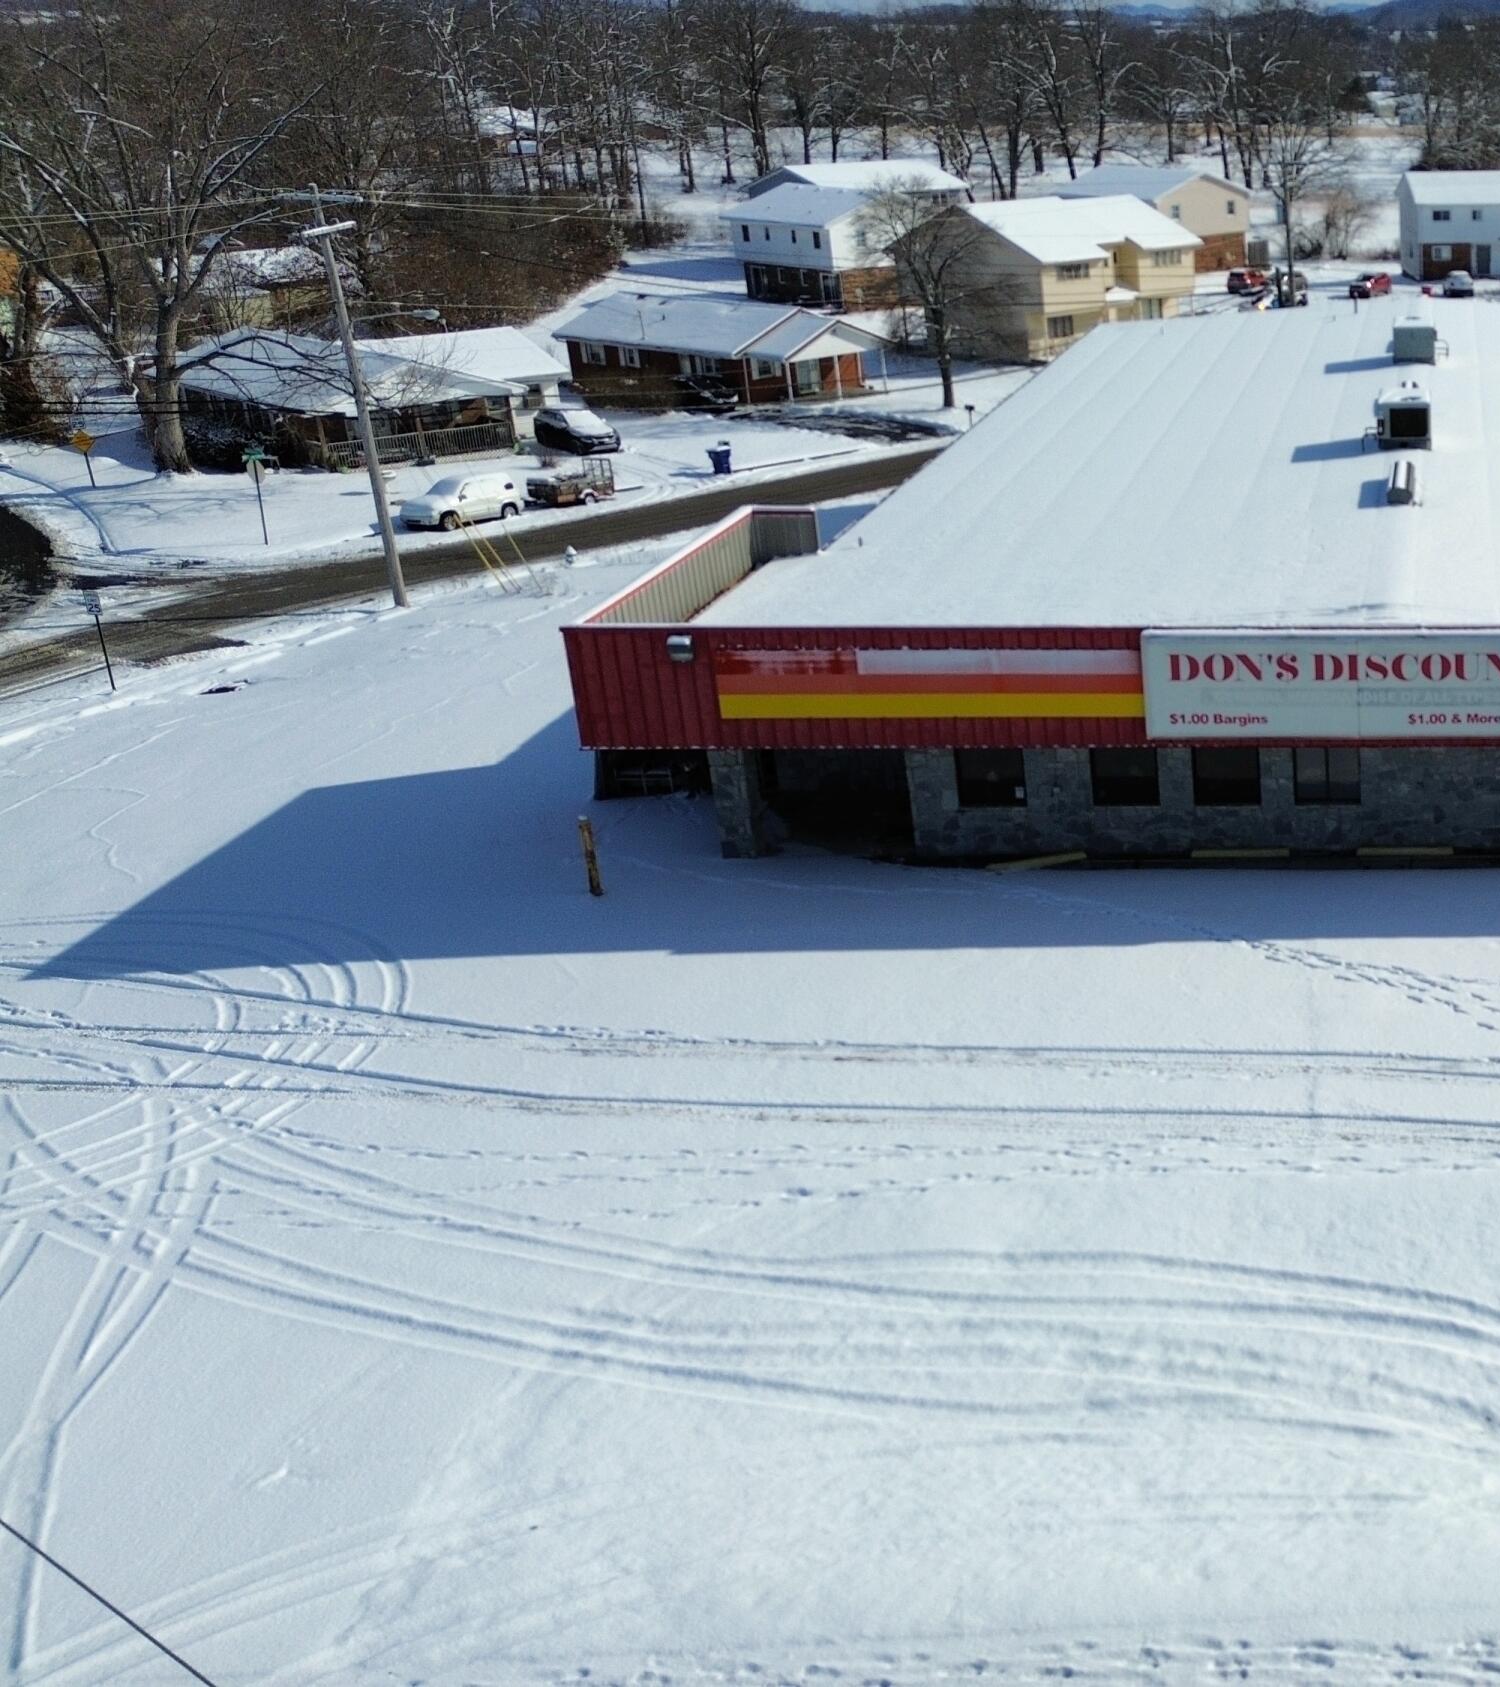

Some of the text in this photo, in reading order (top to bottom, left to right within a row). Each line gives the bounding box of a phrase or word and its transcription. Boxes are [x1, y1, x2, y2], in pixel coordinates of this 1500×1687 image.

[88, 603, 101, 613] 25
[1169, 653, 1299, 682] DON'S
[1170, 713, 1269, 727] $1.00 Bargins
[1408, 713, 1447, 725] $1.00
[1451, 713, 1462, 724] &
